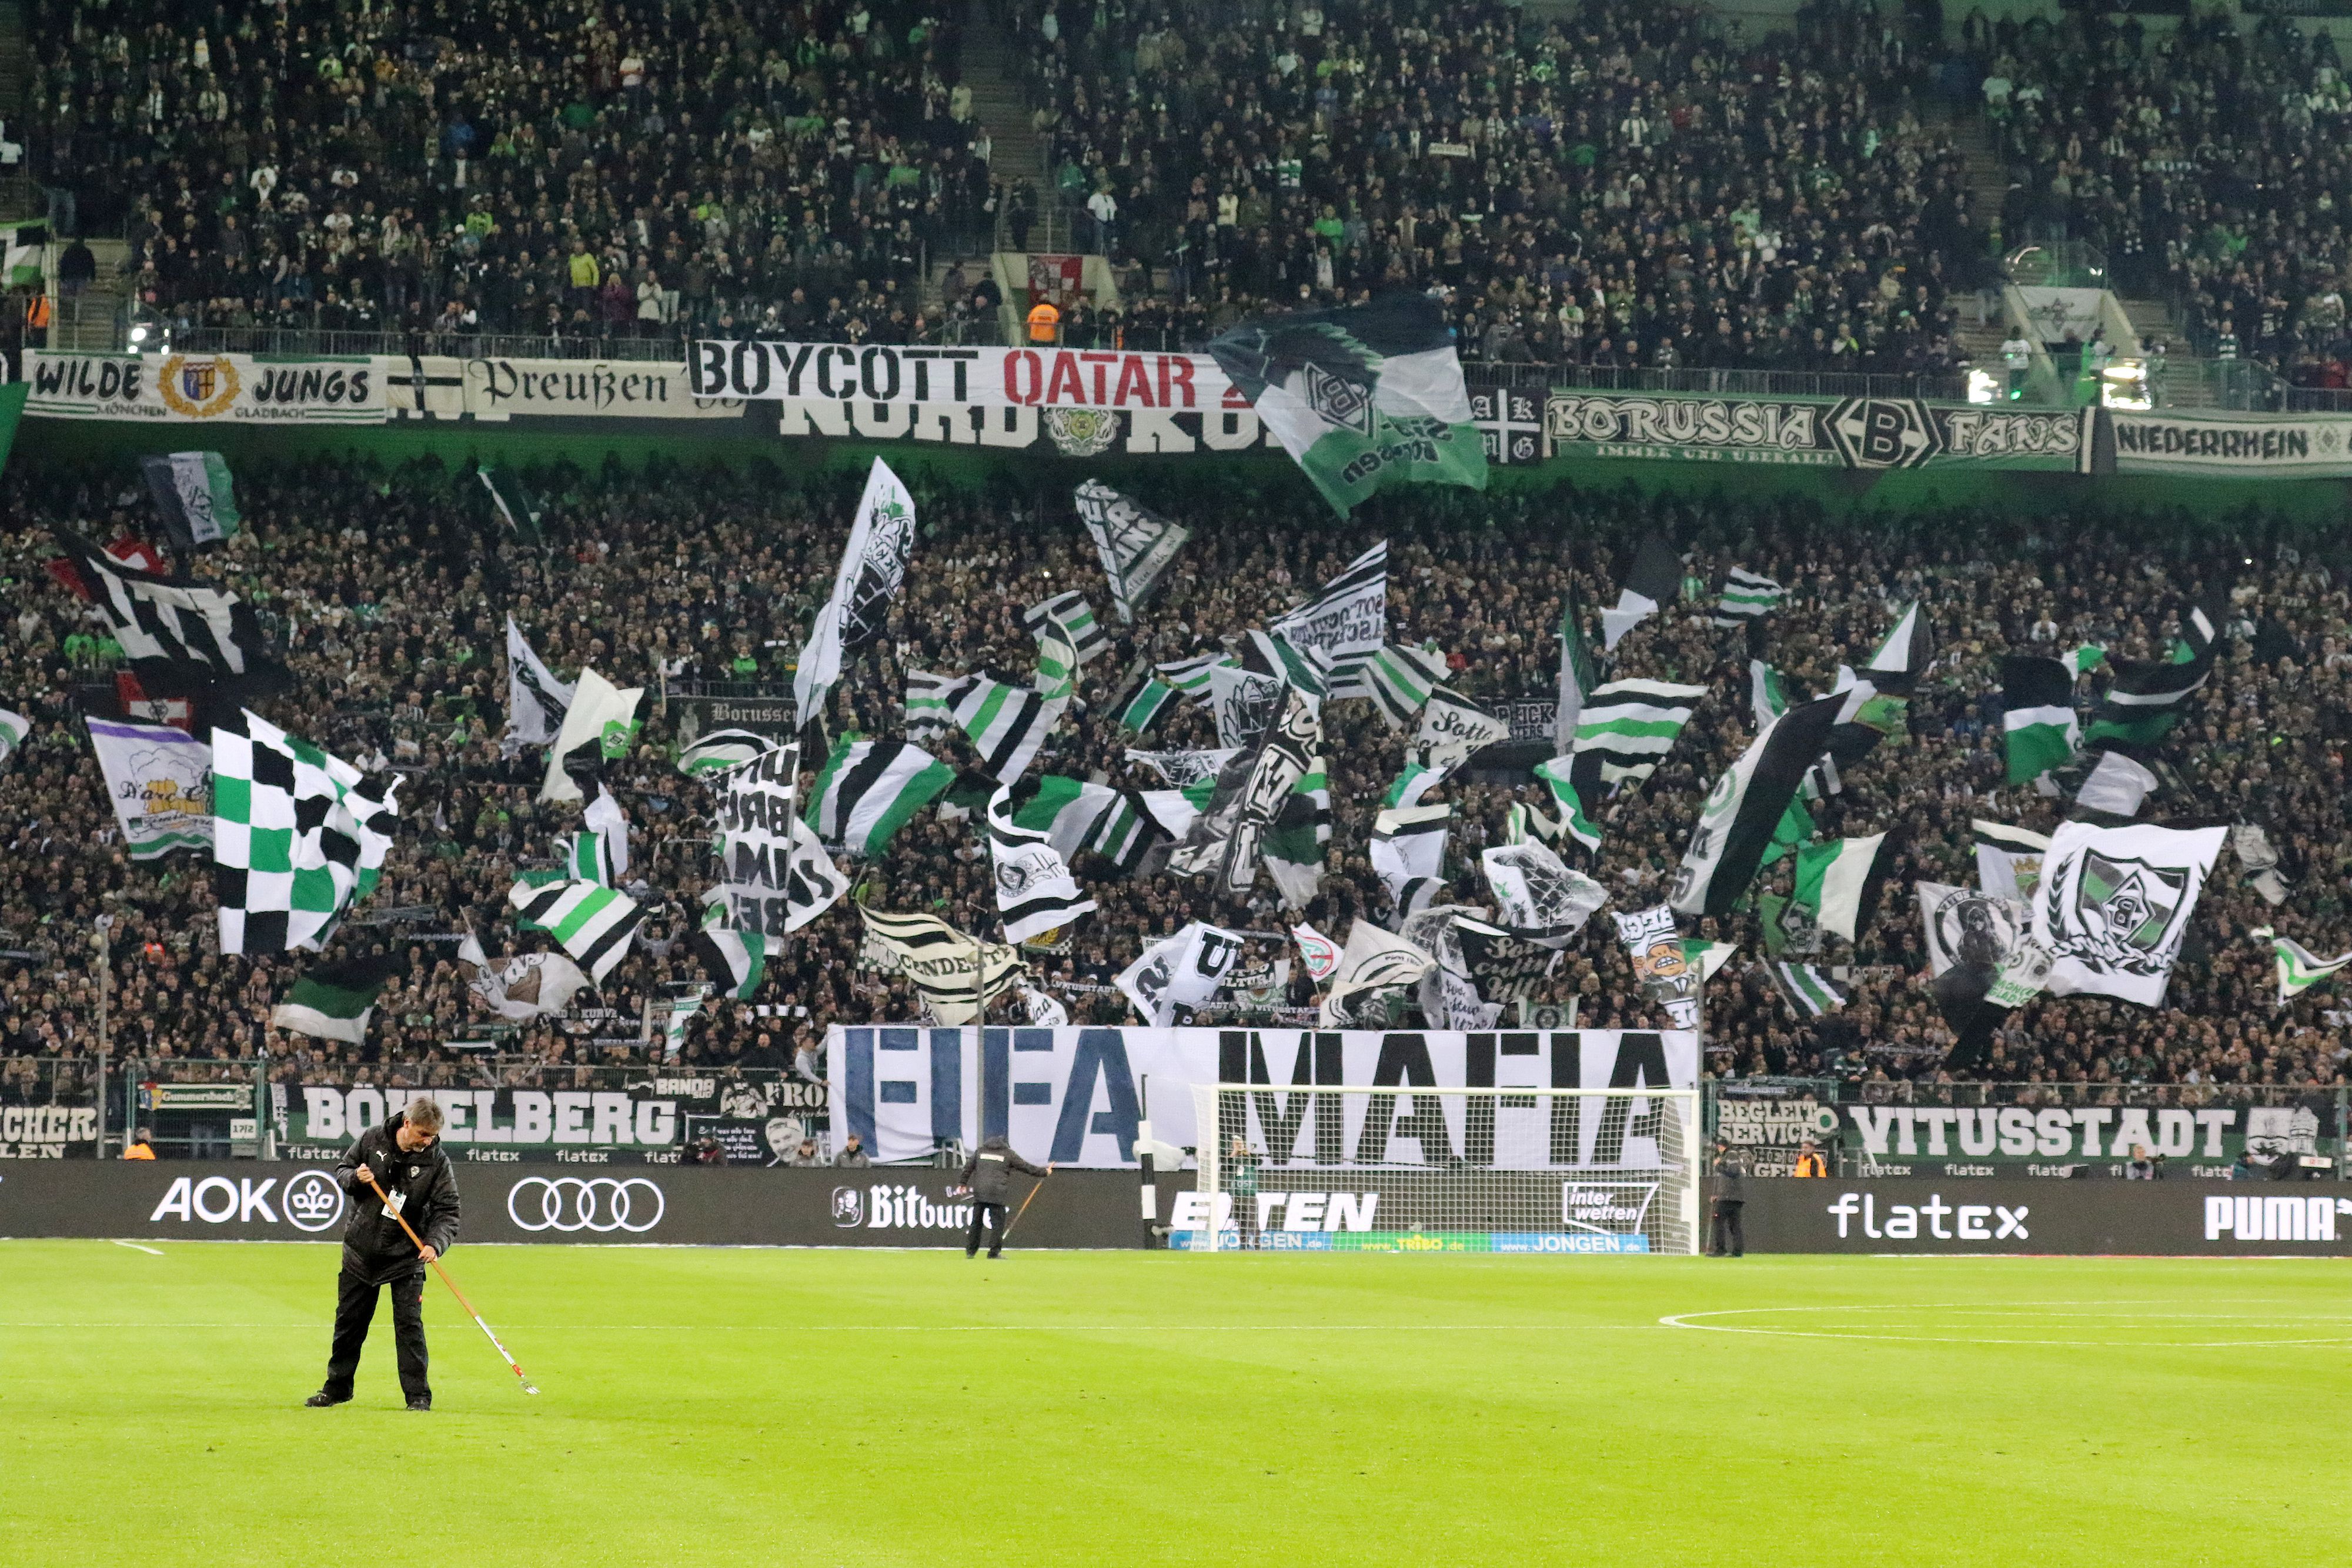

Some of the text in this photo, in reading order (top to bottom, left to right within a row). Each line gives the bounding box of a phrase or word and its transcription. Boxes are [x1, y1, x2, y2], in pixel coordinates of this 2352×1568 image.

[35, 359, 370, 403] WILDE JUNGS
[688, 341, 978, 402] BOYCOTT
[1004, 349, 1195, 407] QATAR
[1548, 396, 1817, 450] BORUSSIA
[1945, 412, 2080, 456] FANS
[2117, 422, 2309, 460] NIEDERRHEIN
[711, 703, 797, 723] Borusse
[845, 1028, 1681, 1166] FIFA MAFIA
[1718, 1100, 1818, 1124] BEGLEIT
[0, 1107, 97, 1143] CHER
[1718, 1122, 1816, 1145] SERVICE
[1848, 1106, 2236, 1158] VITUSSTADT
[287, 1146, 341, 1160] flatex
[466, 1148, 520, 1162] flatex
[555, 1149, 609, 1163] flatex
[1945, 1164, 1994, 1176] flatex
[150, 1176, 279, 1223] AOK
[1569, 1185, 1614, 1205] inter
[1575, 1205, 1638, 1221] wetten
[1827, 1192, 2030, 1240] flatex
[2204, 1196, 2335, 1242] PUMA
